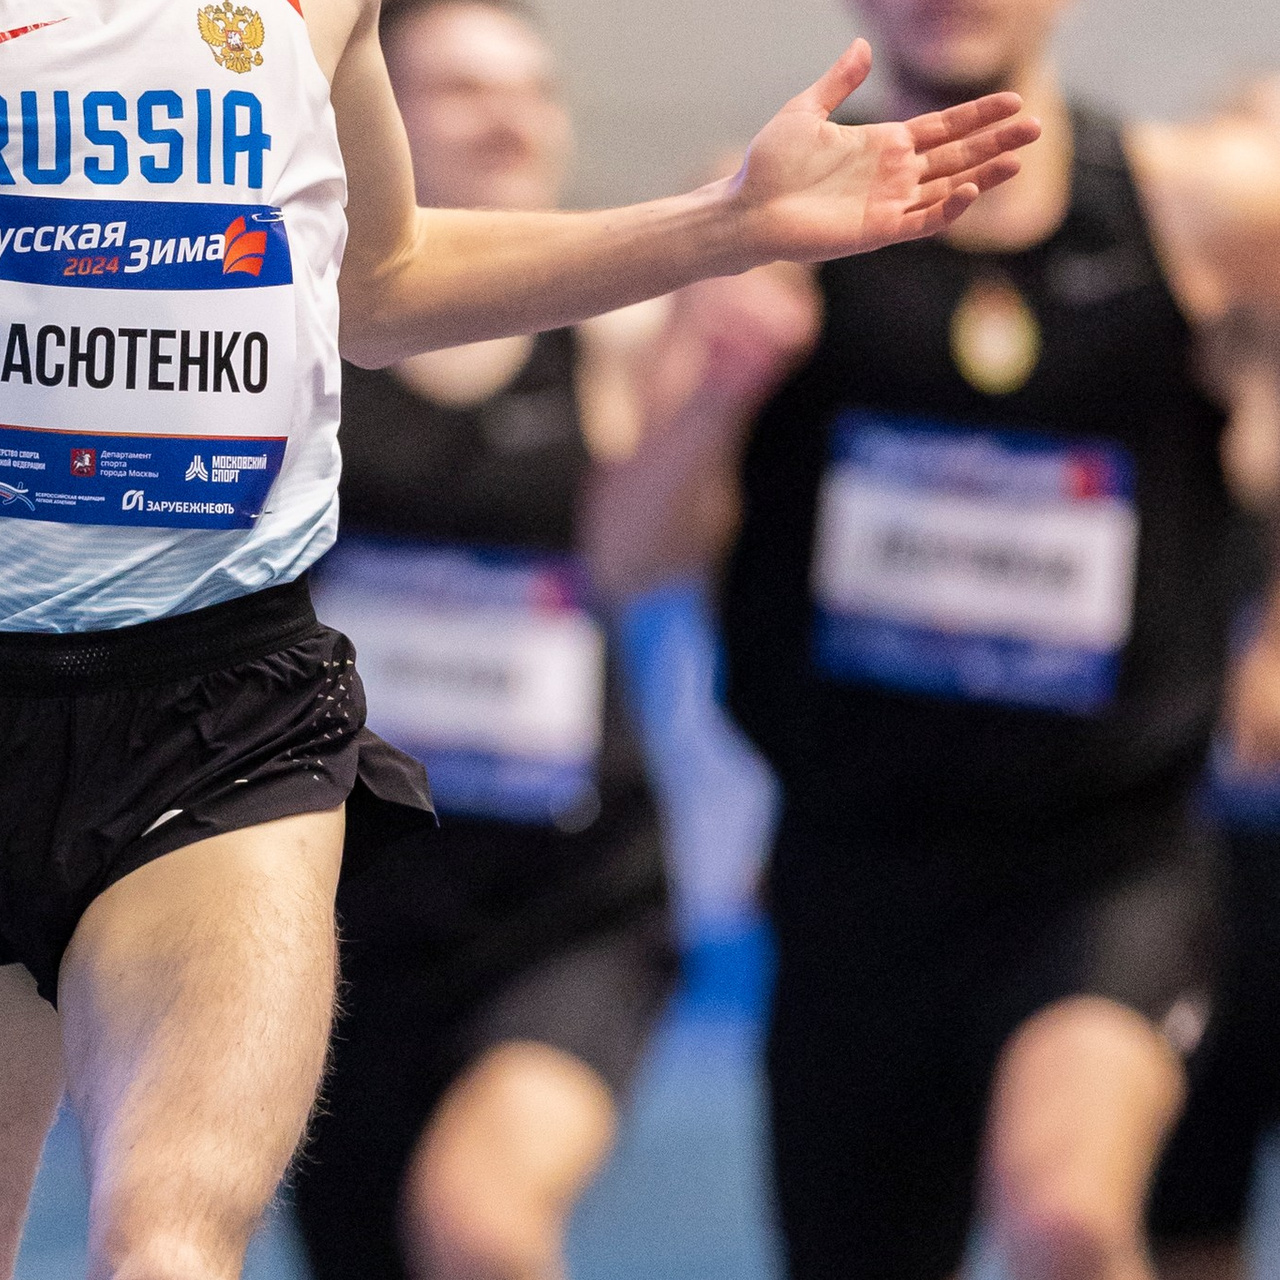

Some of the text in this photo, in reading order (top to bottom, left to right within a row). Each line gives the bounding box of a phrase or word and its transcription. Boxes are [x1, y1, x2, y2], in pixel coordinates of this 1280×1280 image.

[123, 233, 227, 274] Зима
[63, 257, 120, 277] 2024
[100, 450, 152, 460] Департамент
[212, 454, 268, 470] МОСКОВСКИЙ
[100, 460, 128, 469] спорта
[100, 469, 160, 479] города Москвы
[211, 469, 240, 483] СПОРТ
[146, 500, 235, 515] ЗАРУБЕЖНЕФТЬ
